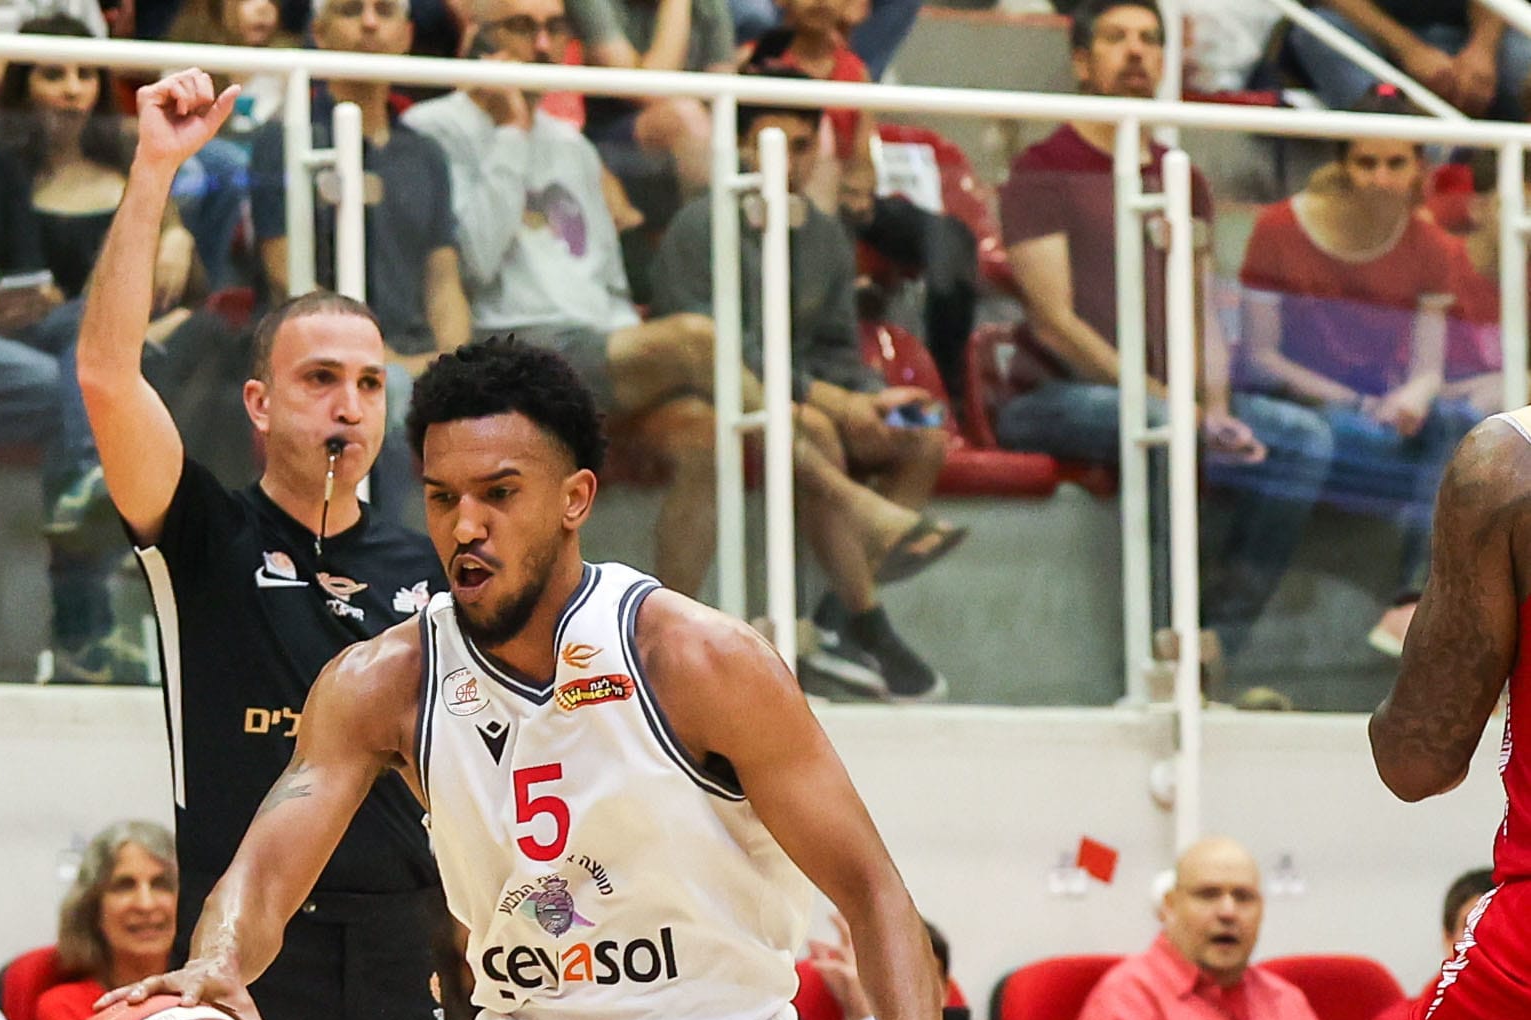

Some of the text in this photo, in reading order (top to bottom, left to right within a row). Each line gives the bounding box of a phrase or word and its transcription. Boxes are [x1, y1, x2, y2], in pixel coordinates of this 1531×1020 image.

[244, 707, 302, 737] לים
[513, 763, 570, 861] 5
[579, 855, 614, 895] מועצה
